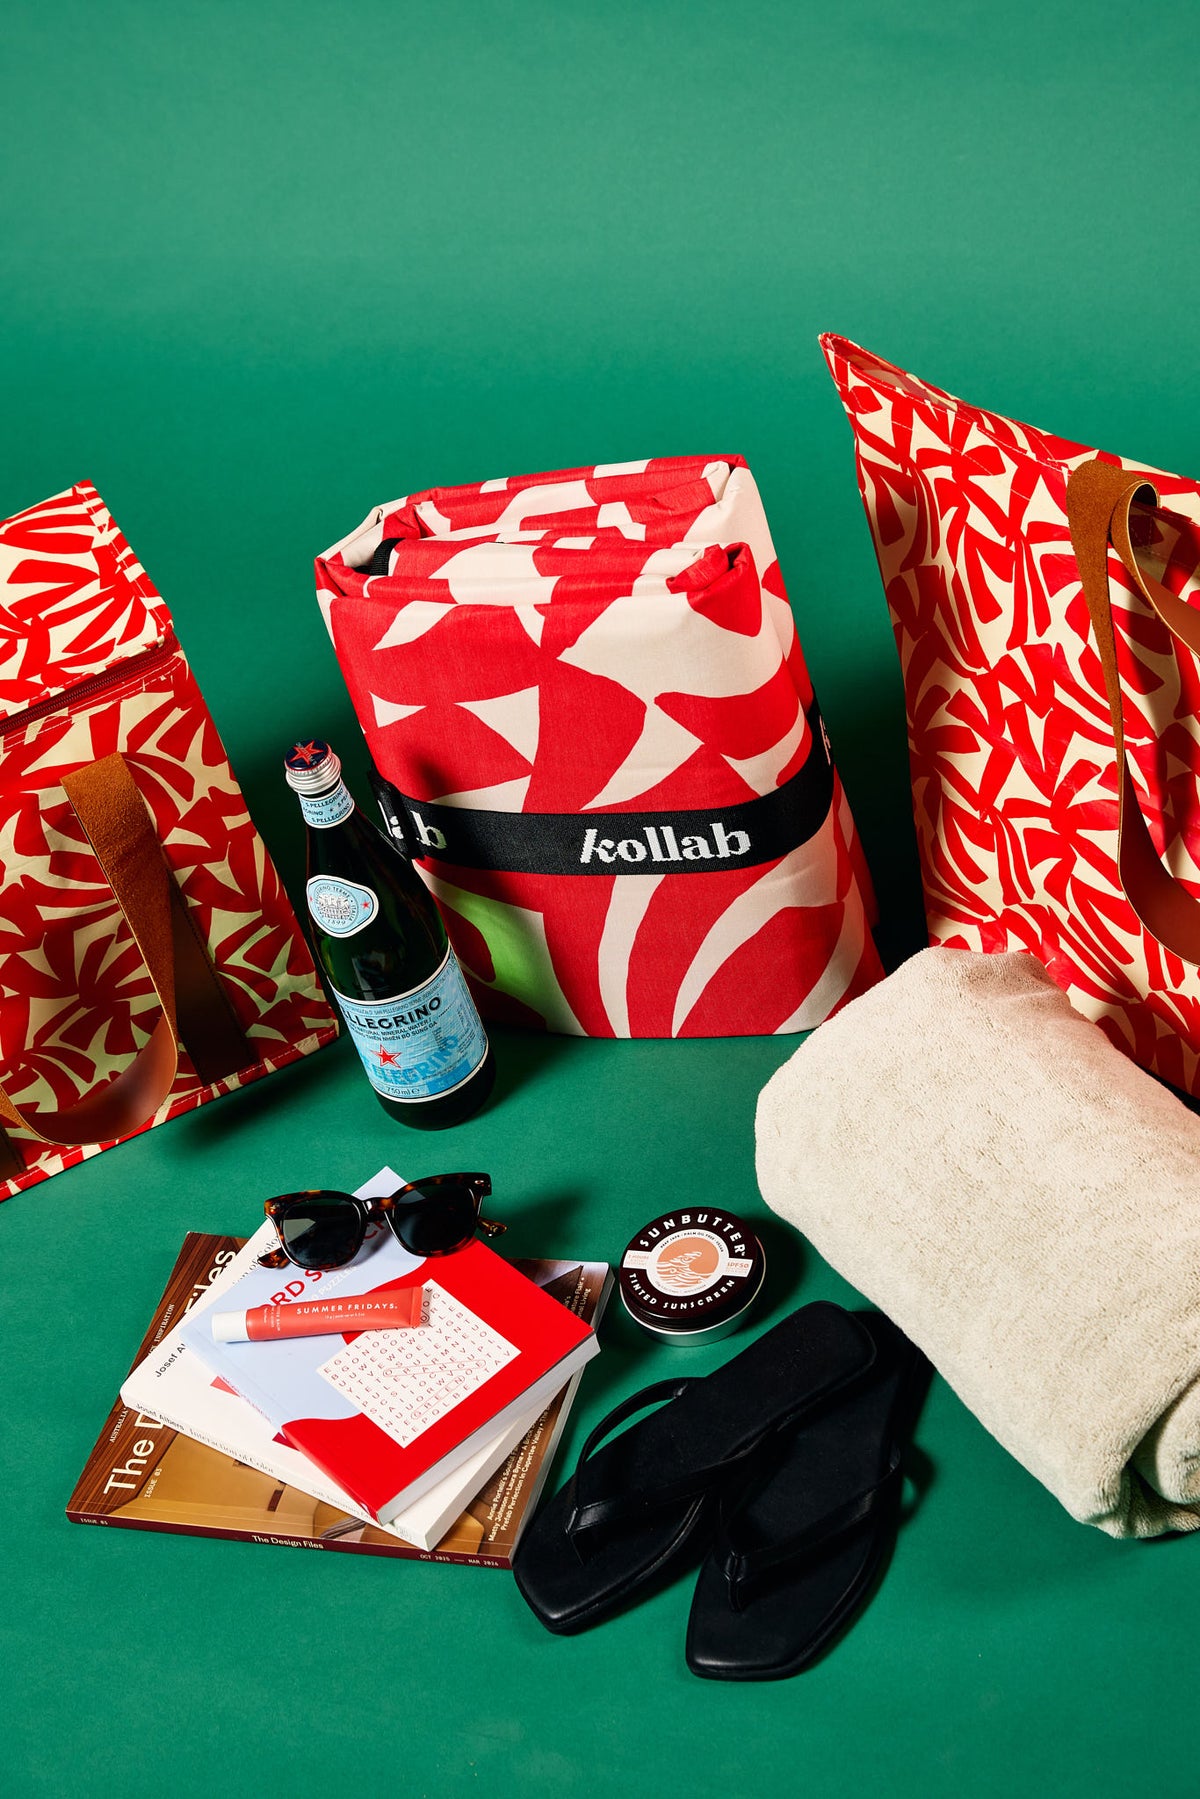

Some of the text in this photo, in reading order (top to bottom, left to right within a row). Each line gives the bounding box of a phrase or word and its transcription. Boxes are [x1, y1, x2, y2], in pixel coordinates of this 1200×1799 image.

[580, 822, 752, 864] kollab
[639, 1213, 746, 1256] SUNBUTTER
[296, 1304, 344, 1315] SUMMER
[628, 1272, 657, 1304] TINTED
[662, 1279, 735, 1310] SUNSCREEN
[154, 1303, 175, 1343] INSPIRATION
[155, 1350, 178, 1378] Josef
[103, 1439, 154, 1495] The
[501, 1509, 513, 1531] Prefab
[507, 1477, 523, 1509] Perfection
[521, 1445, 537, 1473] Capertee
[531, 1424, 544, 1447] Valley
[488, 1521, 501, 1542] Matty
[496, 1496, 509, 1522] Johnson
[506, 1472, 517, 1491] Laura
[513, 1456, 524, 1474] Byrne
[252, 1535, 324, 1550] The Design Files
